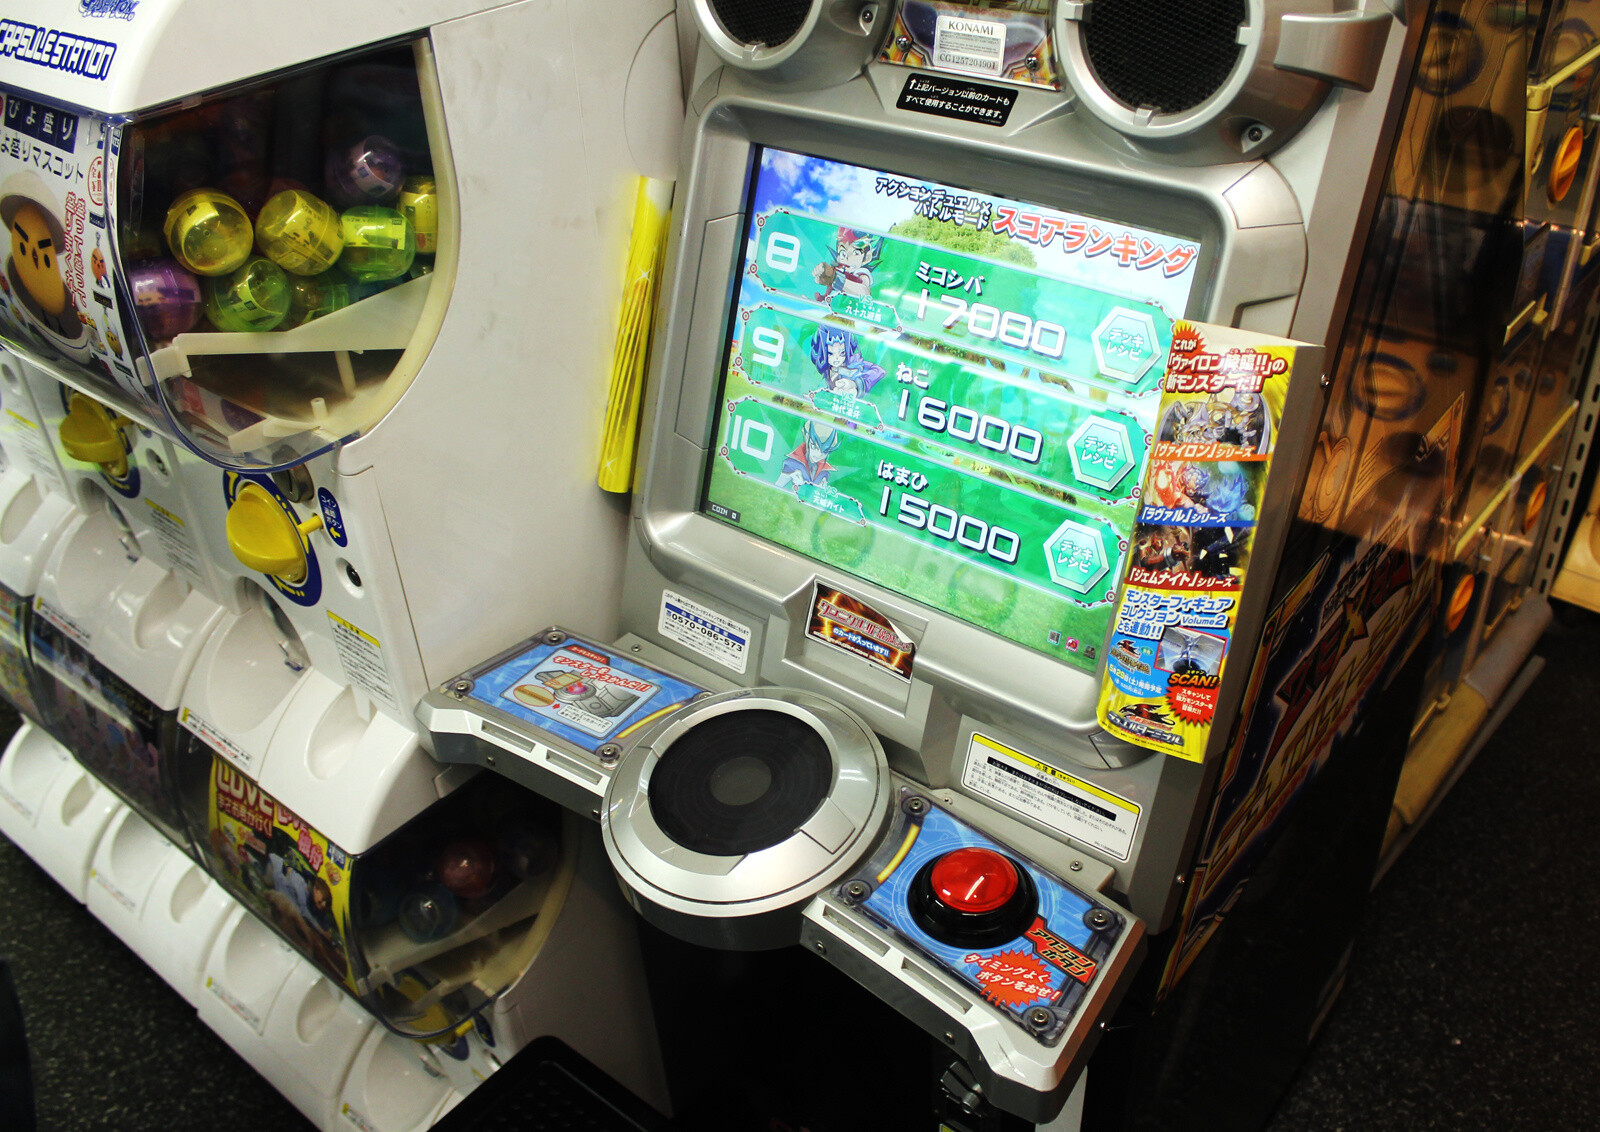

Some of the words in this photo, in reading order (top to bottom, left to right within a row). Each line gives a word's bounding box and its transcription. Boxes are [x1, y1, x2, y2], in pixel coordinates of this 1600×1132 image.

[949, 21, 994, 35] KONAMI
[915, 82, 1010, 106] 上記バージョン以前のカードも
[905, 95, 1003, 119] すべて使用することができます。
[914, 199, 992, 230] バトルモード
[766, 231, 800, 273] 8
[992, 206, 1197, 277] スコアランキング
[915, 261, 985, 296] ミコシバ
[917, 288, 1068, 361] 17080
[752, 326, 784, 368] 9
[1109, 327, 1145, 348] デッキ
[1173, 339, 1198, 351] これが
[1106, 341, 1142, 362] レシピ
[896, 361, 930, 389] ねこ
[731, 415, 774, 461] 10
[897, 388, 1043, 464] 16000
[1083, 436, 1119, 456] デッキ
[1154, 443, 1254, 459] 「ヴァイロン」シリーズ
[1081, 450, 1116, 470] レシピ
[877, 459, 928, 492] はまひ
[711, 504, 728, 516] COIN
[1142, 506, 1228, 523] 「ラヴァル」シリーズ
[879, 485, 1021, 564] 15000
[1059, 540, 1093, 561] デッキ
[1057, 553, 1091, 573] レシピ
[1129, 568, 1235, 588] 「ジェムナイト」シリーズ
[1126, 589, 1232, 611] モンスターフィギュア
[1121, 604, 1181, 623] コレクション
[671, 613, 743, 652] 0570-086-573
[553, 655, 611, 674] モンスターを
[580, 668, 653, 693] しょうかんだ!!
[1168, 672, 1218, 687] SCAN!
[1182, 688, 1211, 701] スキャンして
[217, 757, 274, 817] LOVE
[1029, 928, 1095, 968] アクション
[966, 954, 1050, 982] タイミングよく
[1042, 949, 1087, 976] ボタン
[977, 971, 1061, 1000] ボタンをおせ!
